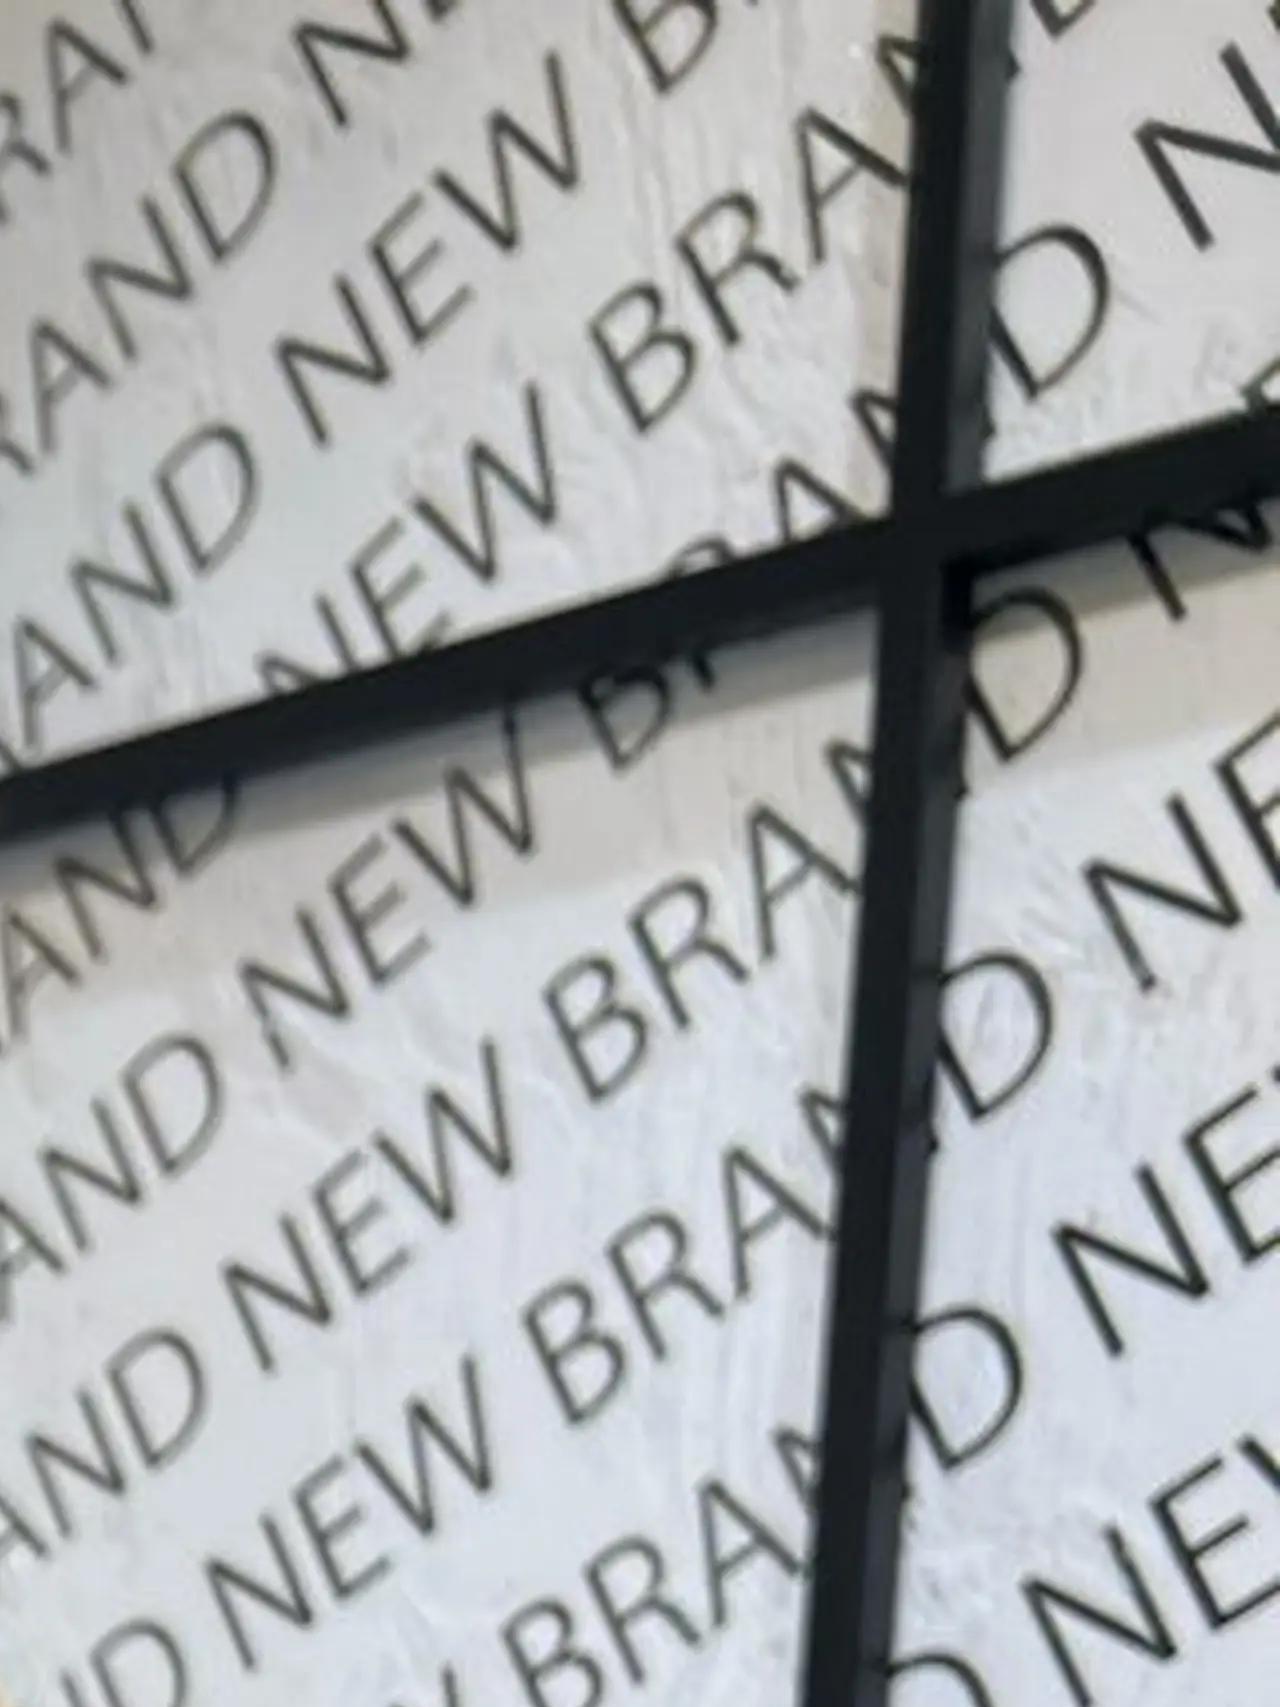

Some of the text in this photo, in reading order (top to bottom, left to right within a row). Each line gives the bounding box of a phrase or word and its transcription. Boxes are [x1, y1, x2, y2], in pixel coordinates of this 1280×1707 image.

[275, 50, 582, 448] NEW
[237, 690, 540, 1074] NEW
[220, 1035, 512, 1374] NEW
[1050, 1060, 1280, 1360] NE
[202, 1352, 493, 1674] NEW
